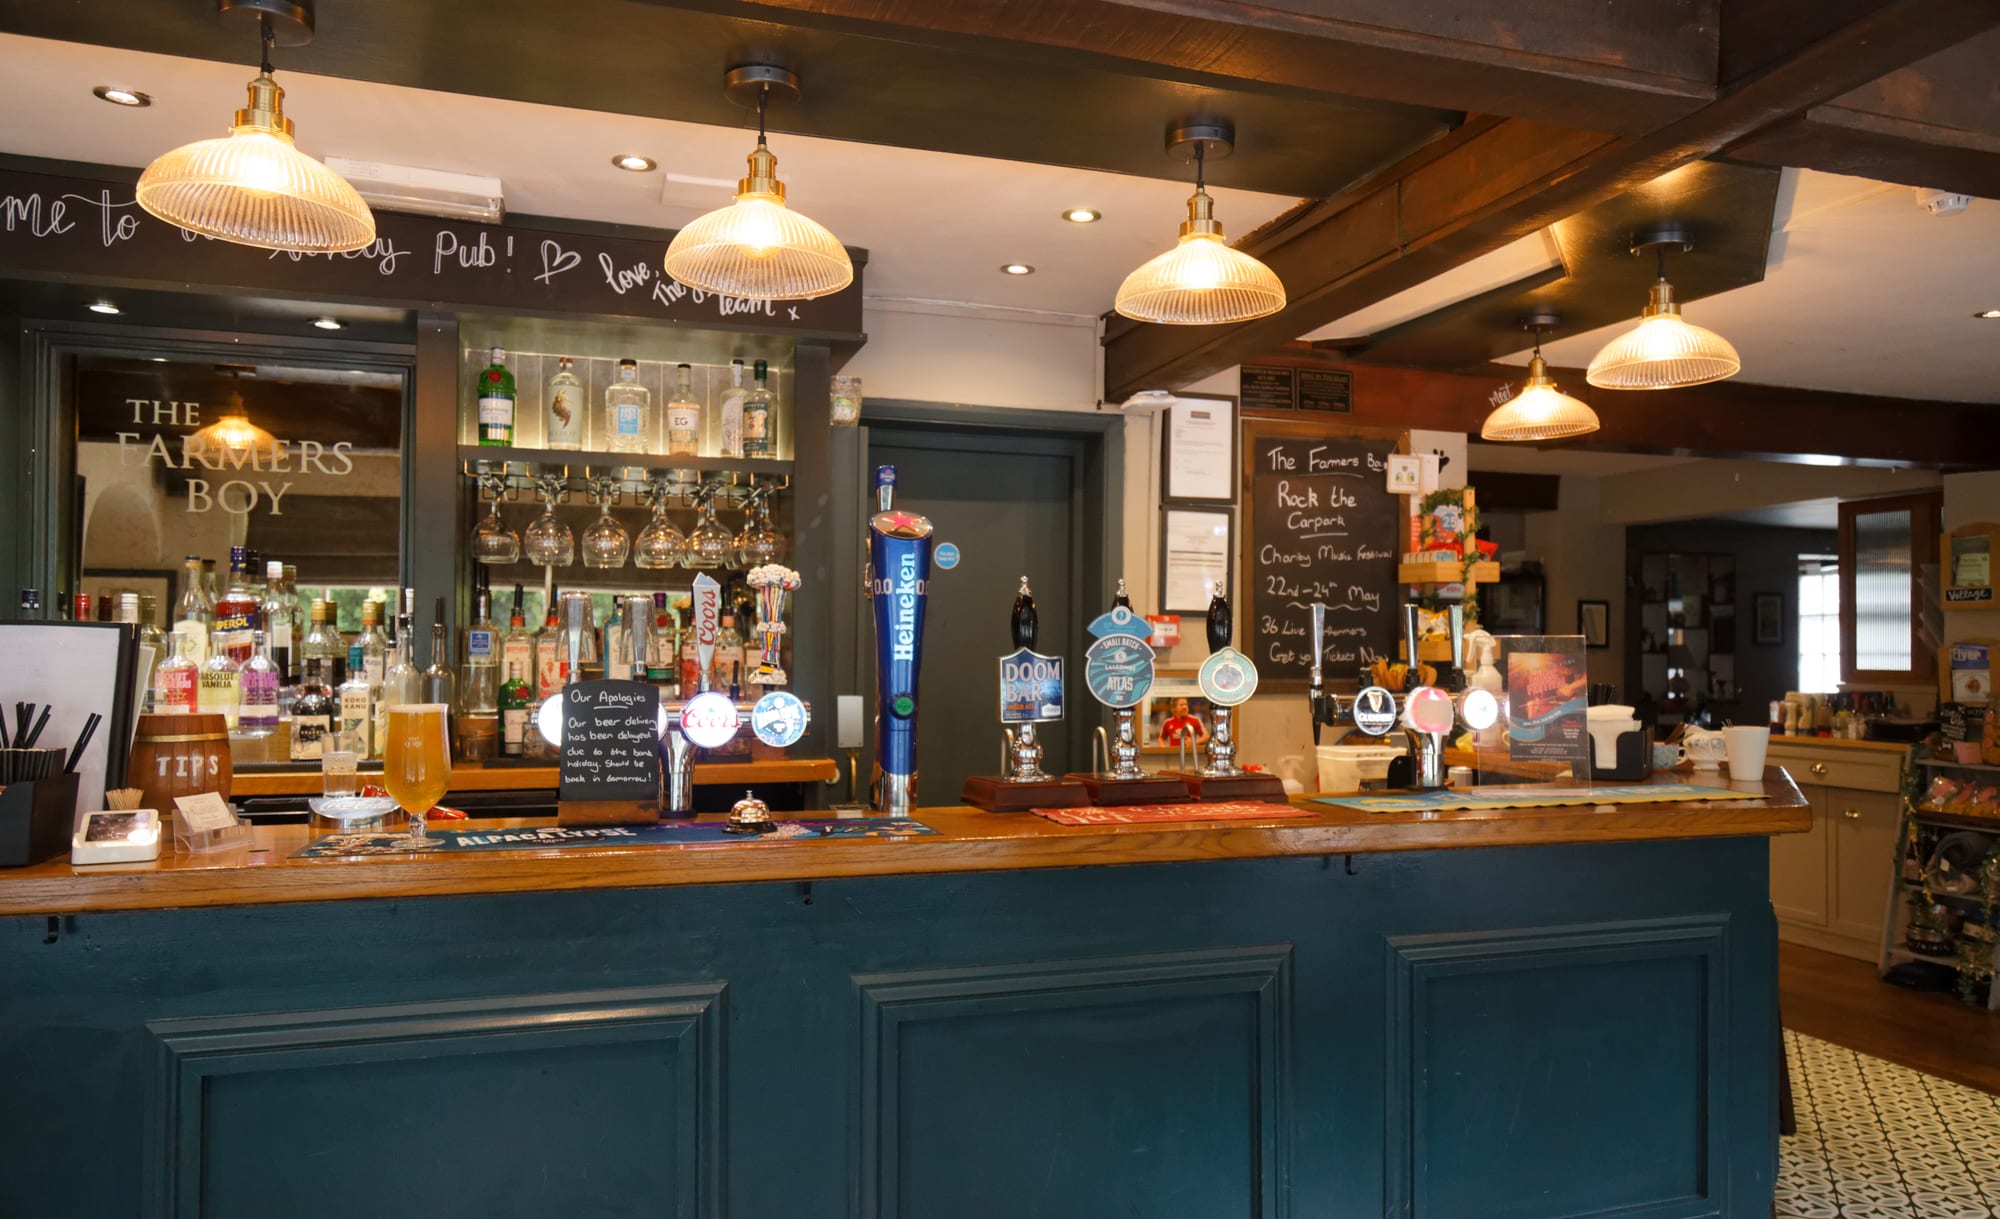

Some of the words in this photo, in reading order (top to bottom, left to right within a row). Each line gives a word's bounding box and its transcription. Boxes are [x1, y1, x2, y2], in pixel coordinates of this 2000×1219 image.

[434, 231, 514, 274] Pub!
[125, 399, 200, 426] THE
[674, 417, 688, 426] EG
[115, 432, 353, 475] FARMERS
[1267, 446, 1296, 471] The
[1309, 446, 1359, 472] Farmers
[185, 478, 293, 516] BOY
[1278, 481, 1318, 508] Rock
[1331, 486, 1357, 507] the
[1287, 512, 1345, 532] Carpark
[1261, 544, 1311, 567] Charity
[1318, 545, 1352, 560] Music
[1357, 544, 1392, 560] Festival
[874, 578, 893, 595] 0.0
[1947, 589, 1988, 600] Village
[893, 552, 916, 662] Heineken
[1348, 585, 1379, 612] May
[699, 589, 716, 646] Coors
[1262, 615, 1279, 634] 36
[1281, 620, 1306, 635] Live
[1270, 642, 1295, 663] Get
[1324, 644, 1355, 661] Tickets
[201, 672, 233, 680] ABSOLUT
[1005, 662, 1060, 682] DOOM
[1006, 682, 1043, 702] BAR
[1107, 676, 1133, 691] ATLAS
[570, 689, 592, 703] Our
[599, 690, 646, 706] Apologies
[568, 717, 587, 729] Our
[595, 717, 620, 727] beer
[625, 716, 658, 730] delivery
[681, 708, 742, 728] Coors
[568, 732, 586, 742] has
[589, 731, 613, 740] been
[618, 731, 652, 743] delayed
[567, 747, 584, 756] due
[593, 747, 602, 756] to
[610, 748, 628, 756] the
[633, 748, 653, 757] bank
[156, 755, 218, 777] TIPS
[605, 759, 629, 768] Should
[634, 760, 644, 768] be
[565, 775, 586, 783] back
